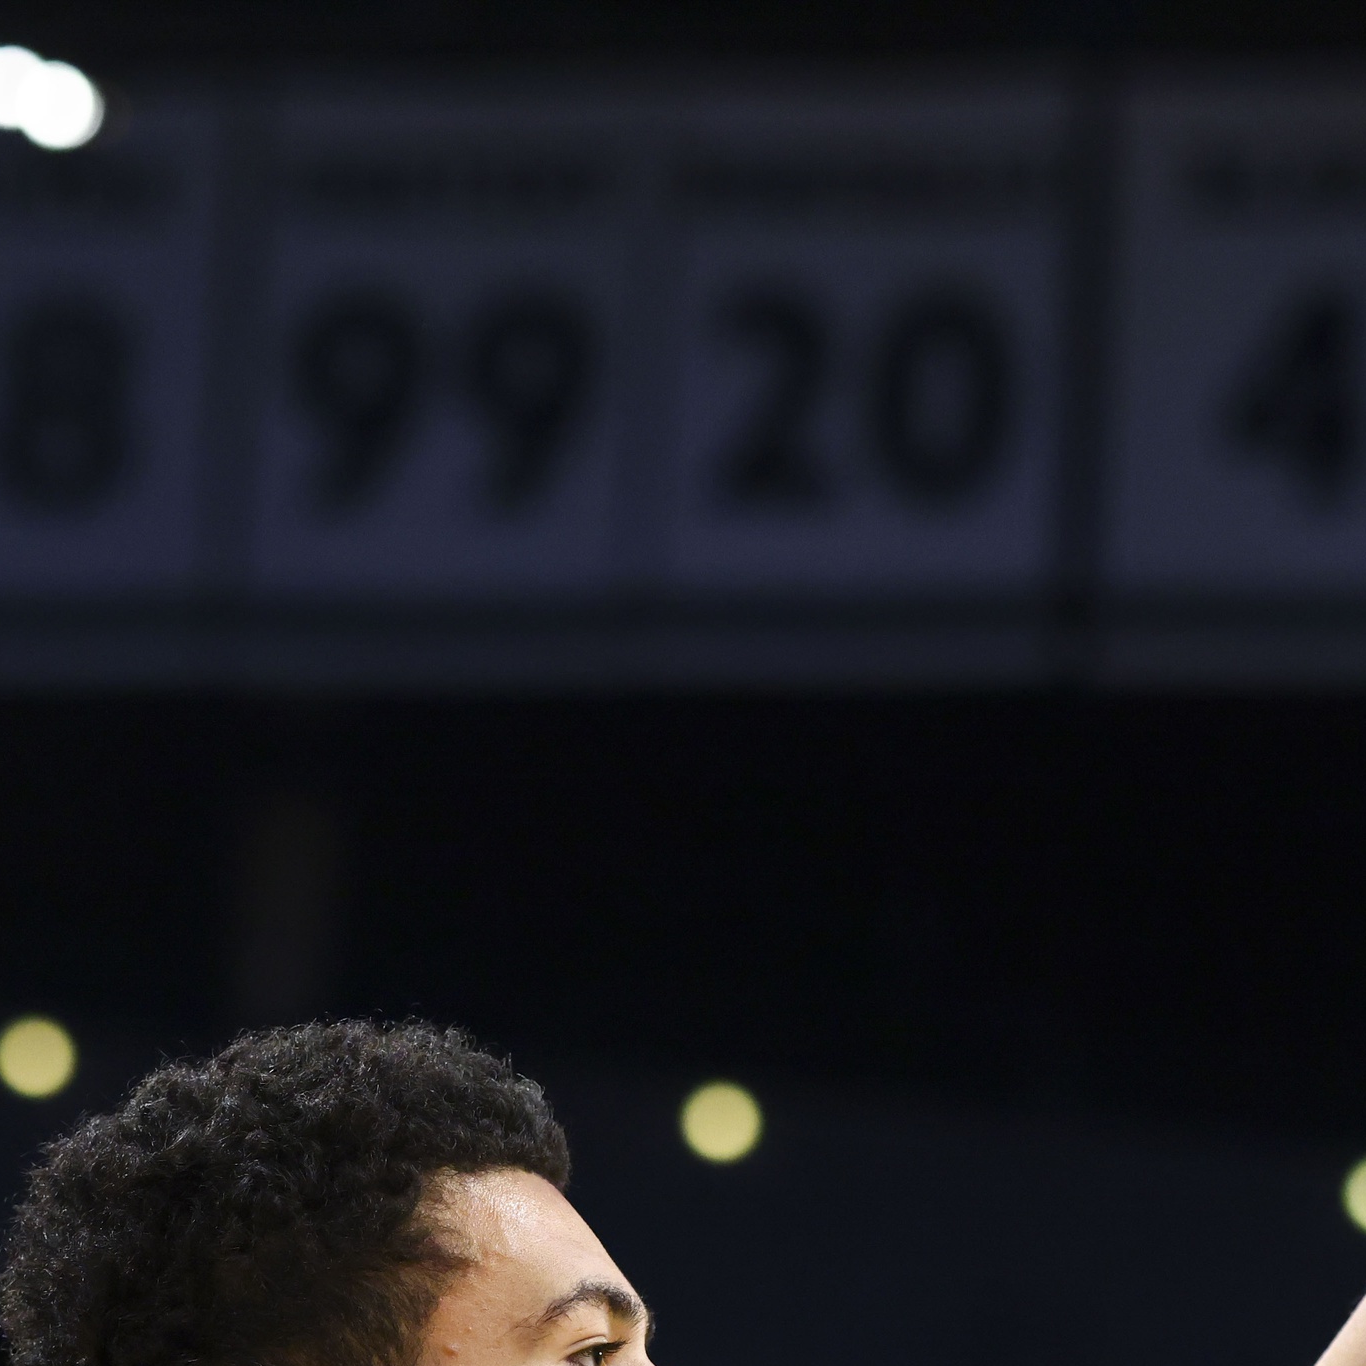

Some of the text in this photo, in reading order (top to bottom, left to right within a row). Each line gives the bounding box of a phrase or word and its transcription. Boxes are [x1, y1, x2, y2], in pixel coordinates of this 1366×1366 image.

[293, 284, 601, 518] 99
[713, 274, 1017, 510] 20
[1223, 270, 1366, 512] 4
